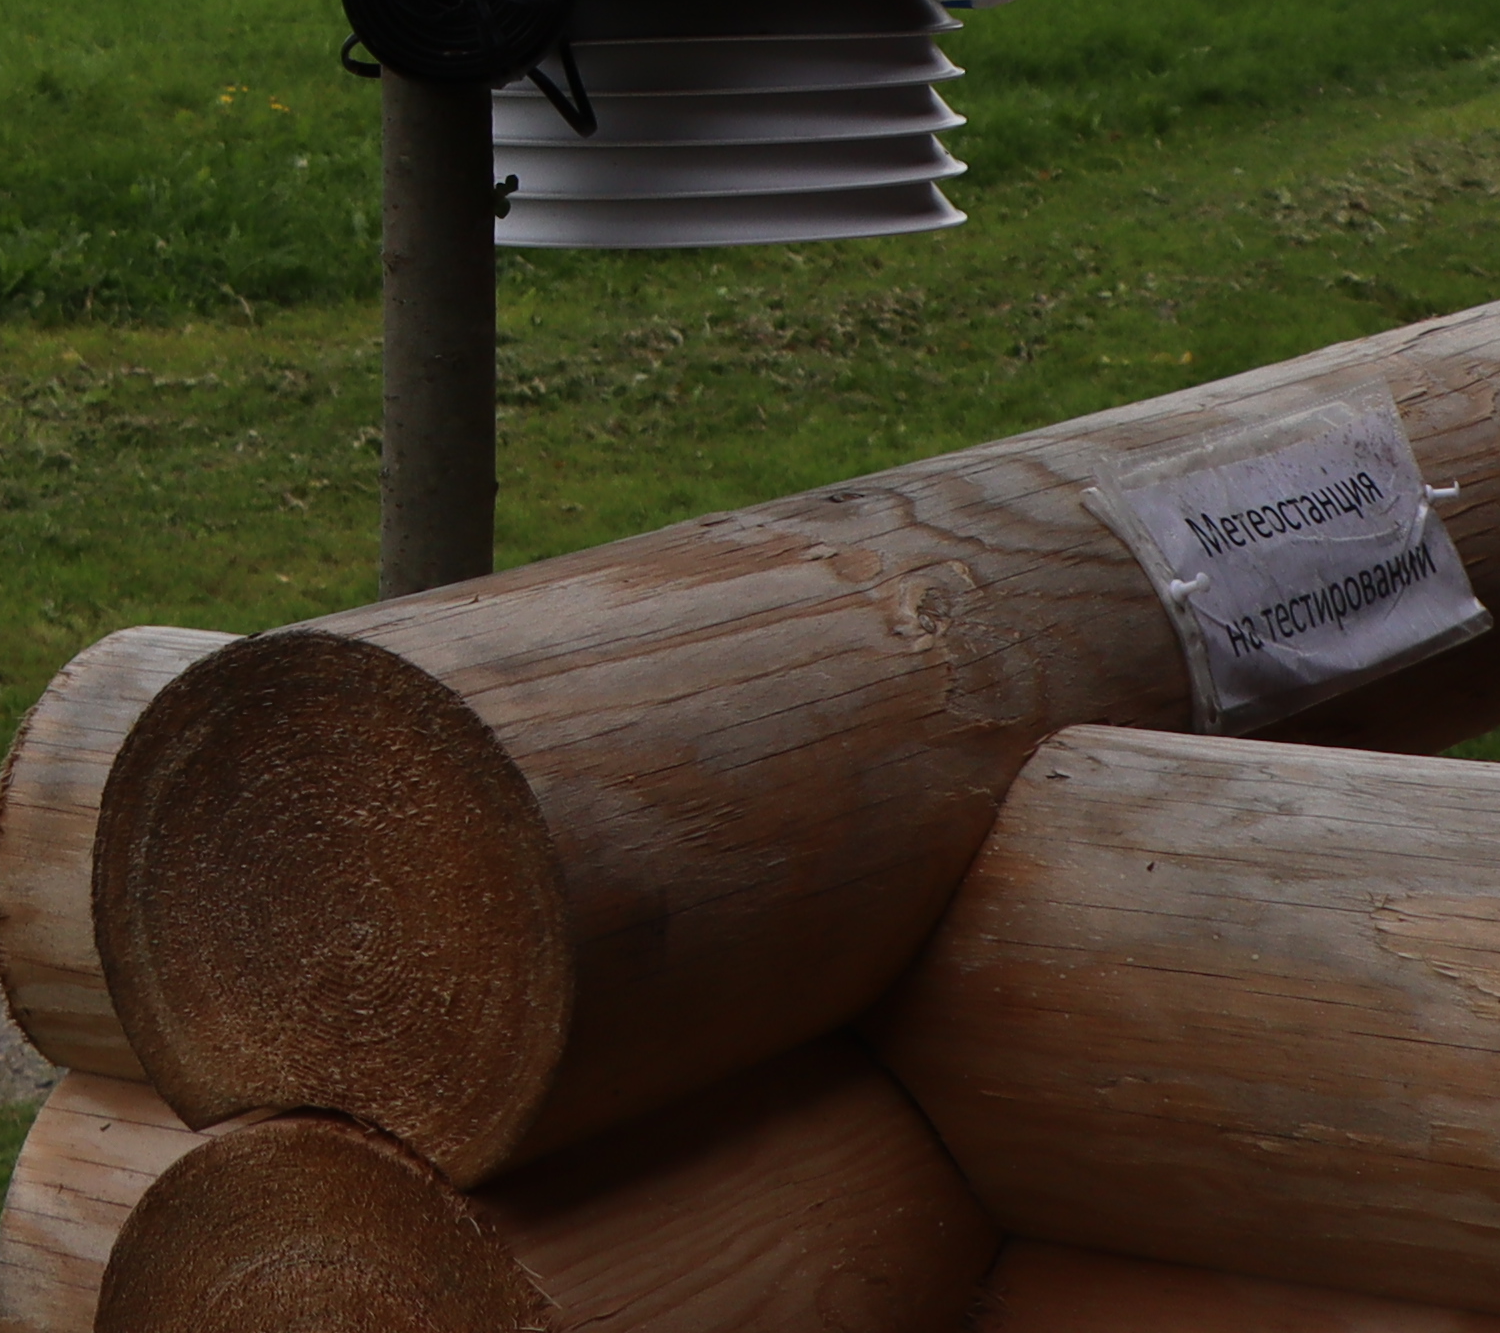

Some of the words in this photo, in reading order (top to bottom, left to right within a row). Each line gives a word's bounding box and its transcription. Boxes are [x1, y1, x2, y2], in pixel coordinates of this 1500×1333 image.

[1185, 472, 1384, 557] Метеостанция
[1226, 615, 1264, 657] на
[1261, 542, 1437, 641] тестировании
